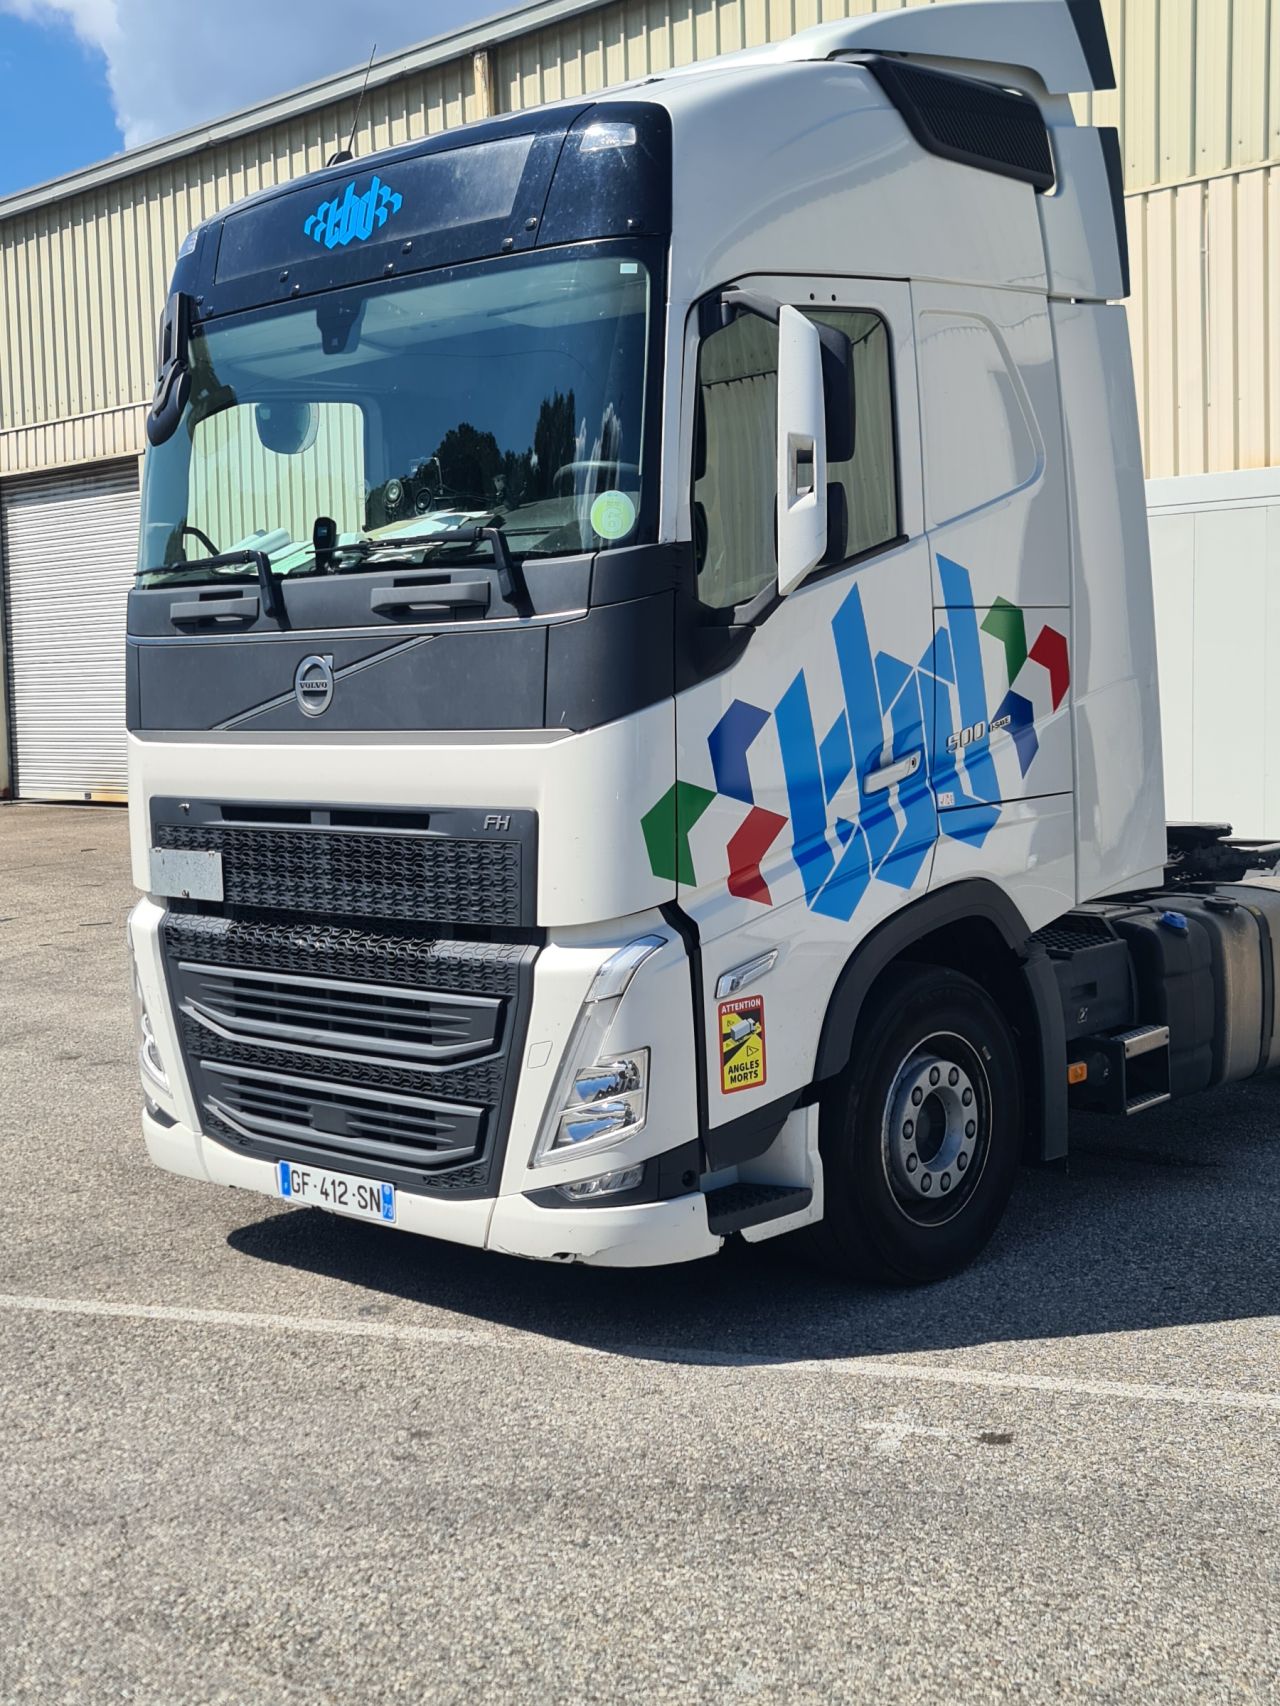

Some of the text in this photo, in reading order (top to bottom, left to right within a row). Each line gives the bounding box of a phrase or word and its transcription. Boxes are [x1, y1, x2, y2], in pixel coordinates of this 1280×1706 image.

[299, 681, 328, 689] VOLVO
[946, 720, 986, 754] 500
[483, 814, 511, 831] FH
[721, 998, 761, 1014] ATTENTION
[728, 1059, 760, 1075] ANGLES
[730, 1070, 759, 1085] MORTS
[383, 1203, 394, 1217] 73
